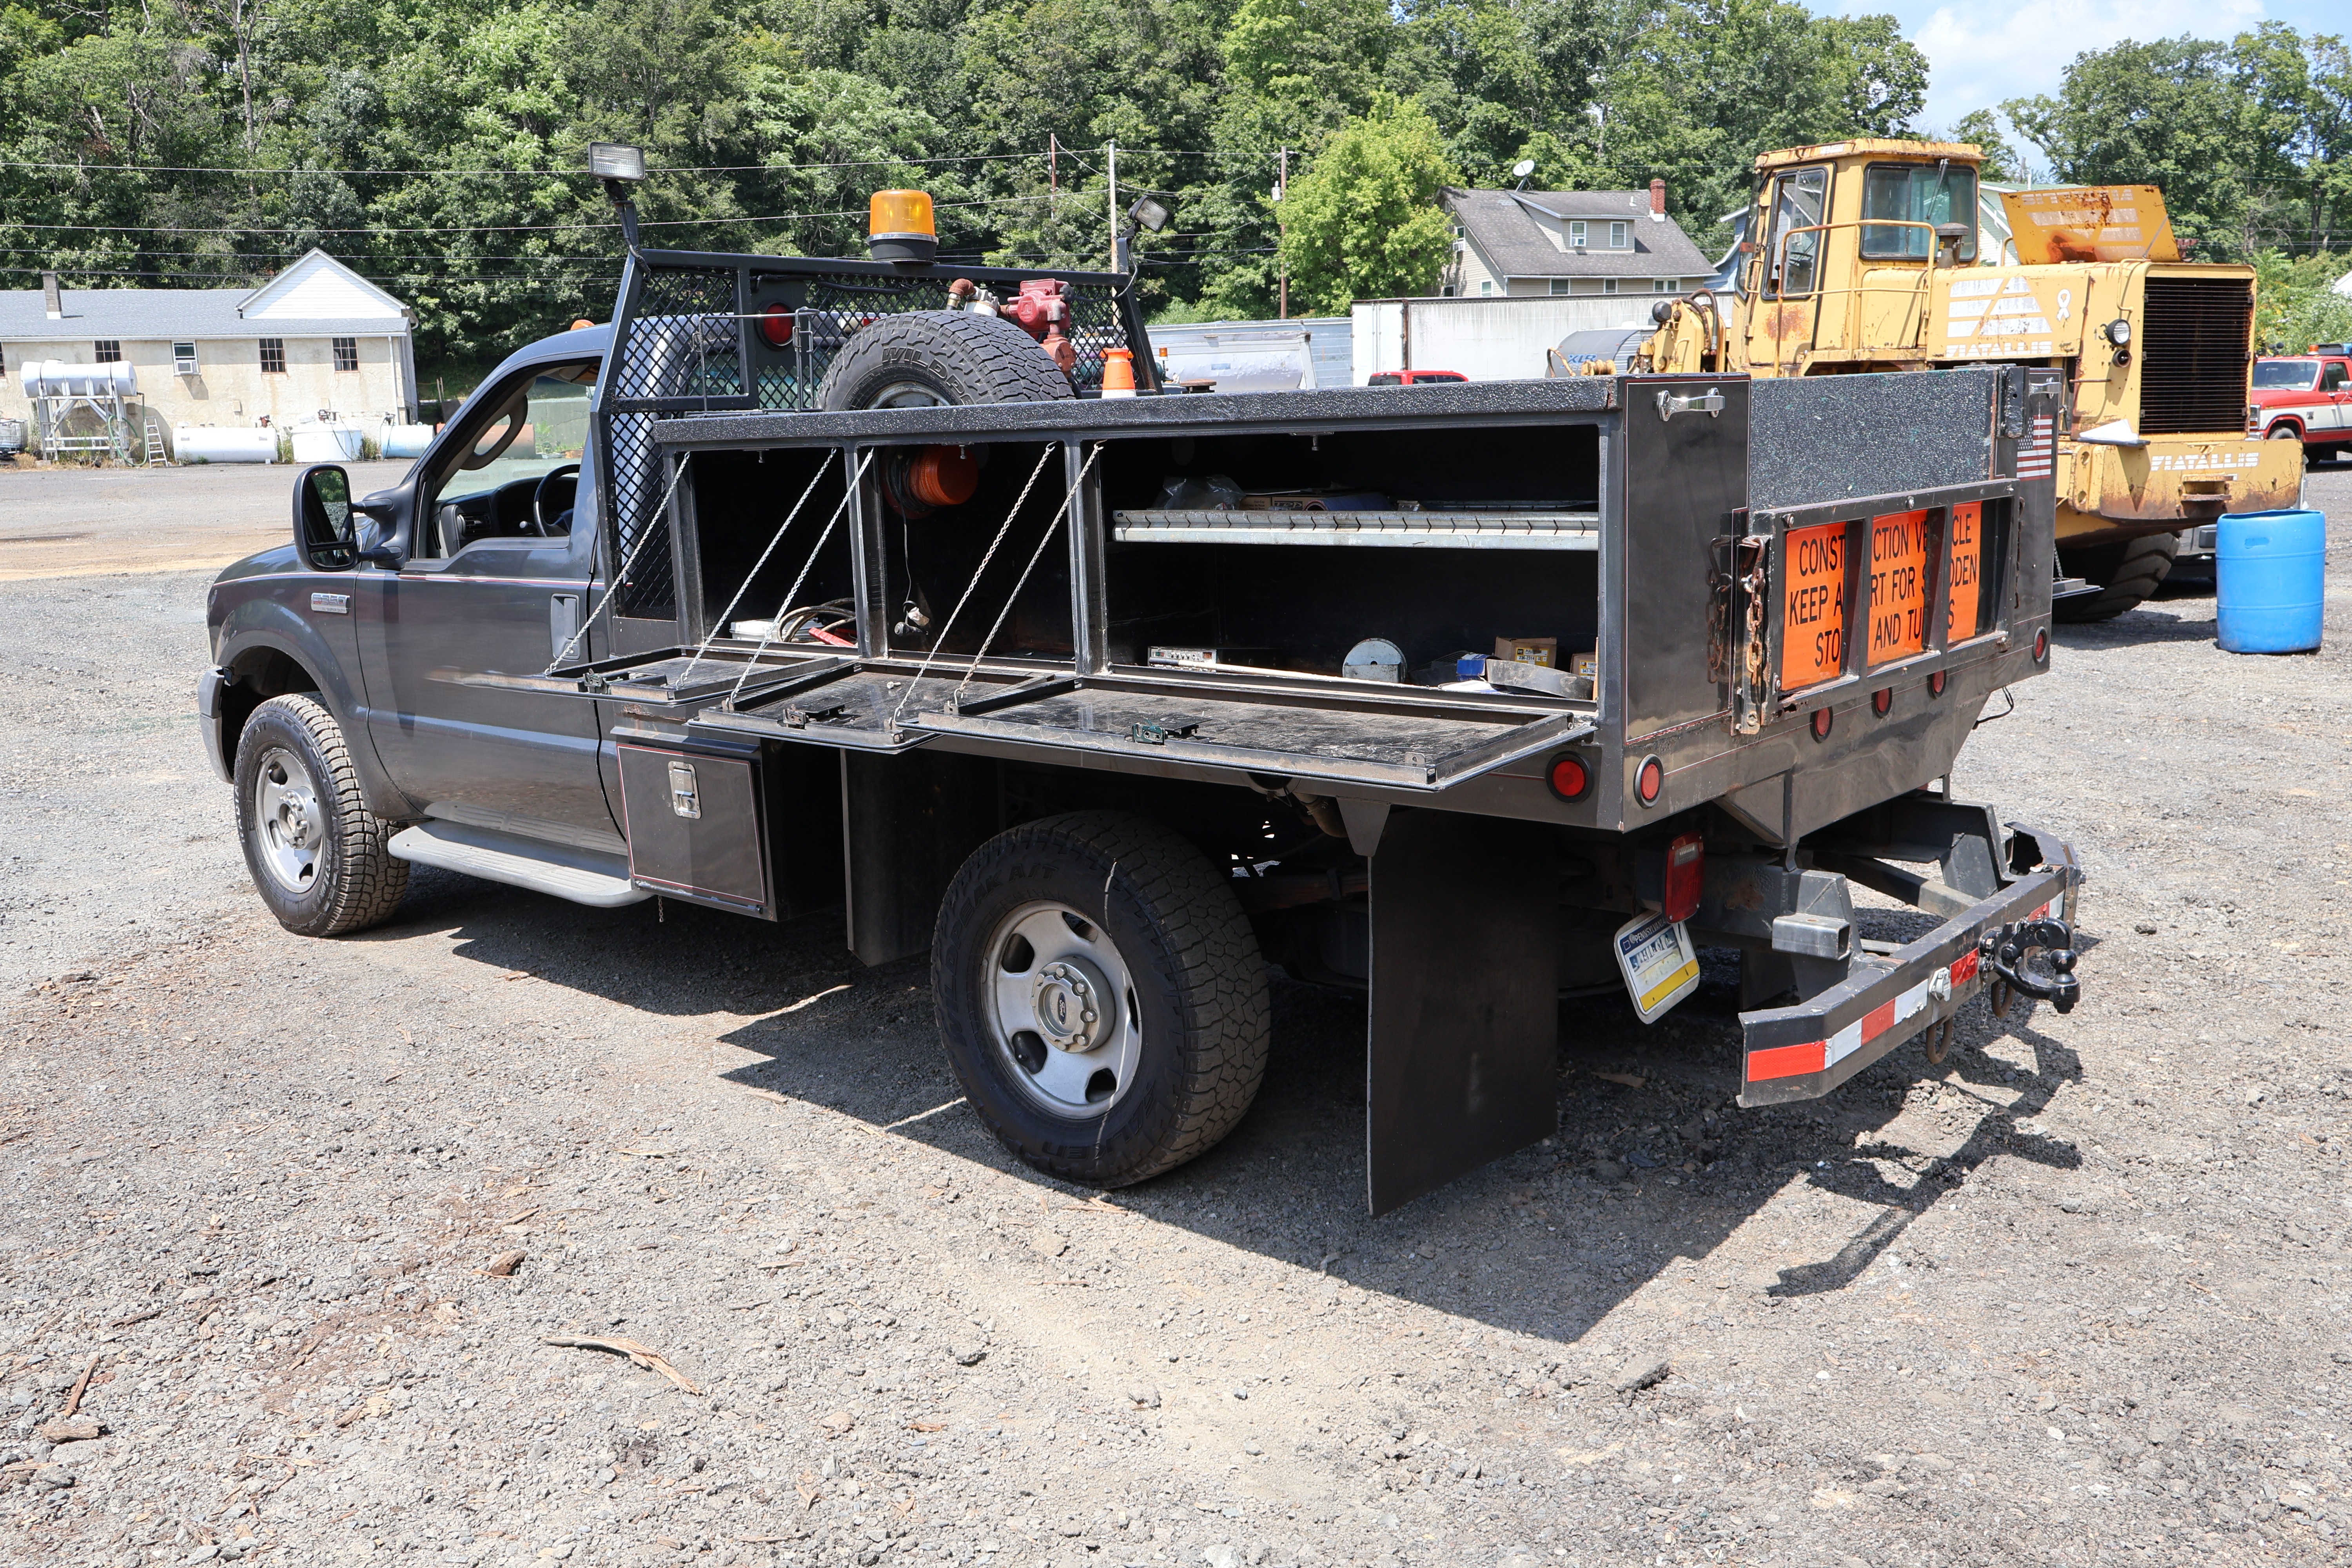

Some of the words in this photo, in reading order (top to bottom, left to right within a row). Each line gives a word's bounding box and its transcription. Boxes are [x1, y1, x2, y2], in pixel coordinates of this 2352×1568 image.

[1946, 341, 2052, 358] FIATALLIS
[2151, 452, 2262, 471] FIATALLIS
[1800, 523, 1909, 576] CONSTCTION
[1789, 585, 1828, 627] KEEP
[1833, 572, 1886, 616] ART
[1892, 566, 1915, 602] FOR
[1815, 628, 1841, 667] STO
[1874, 613, 1901, 651] AND
[941, 871, 1004, 1047] WILDPEAK
[1009, 863, 1058, 881] A/T
[1635, 918, 1666, 943] PENNSYLVANIA
